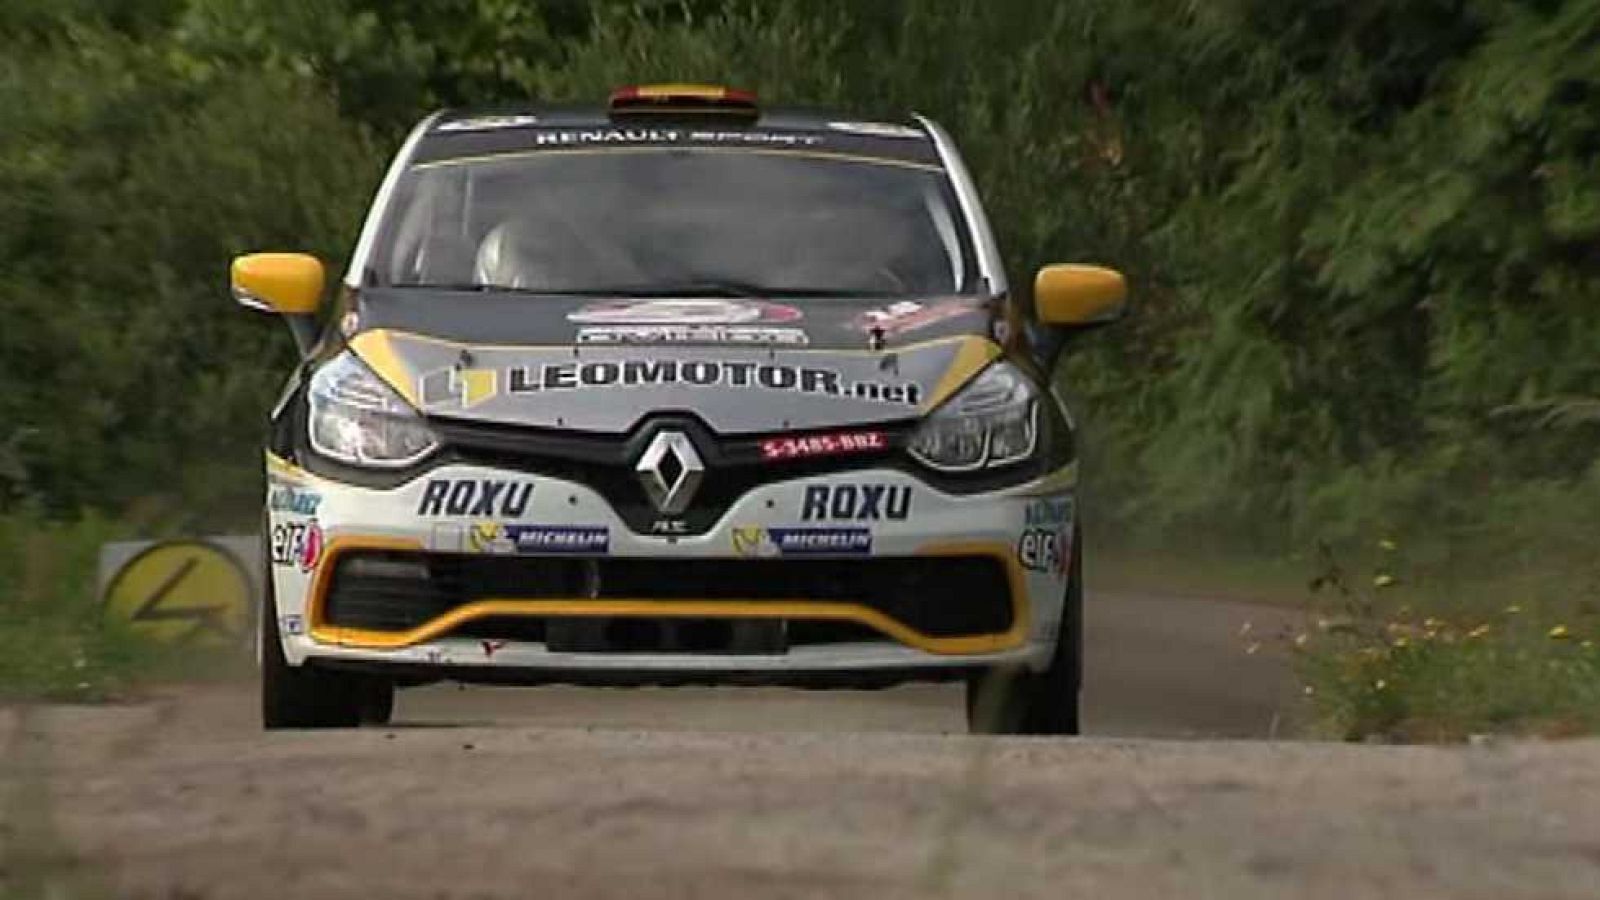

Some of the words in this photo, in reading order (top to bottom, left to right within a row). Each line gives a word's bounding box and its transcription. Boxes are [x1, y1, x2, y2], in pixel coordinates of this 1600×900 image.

[536, 130, 679, 145] RENAULT
[417, 479, 534, 517] ROXU
[802, 483, 912, 521] ROXU
[519, 530, 609, 545] MICHELIN
[782, 534, 871, 548] MICHELIN
